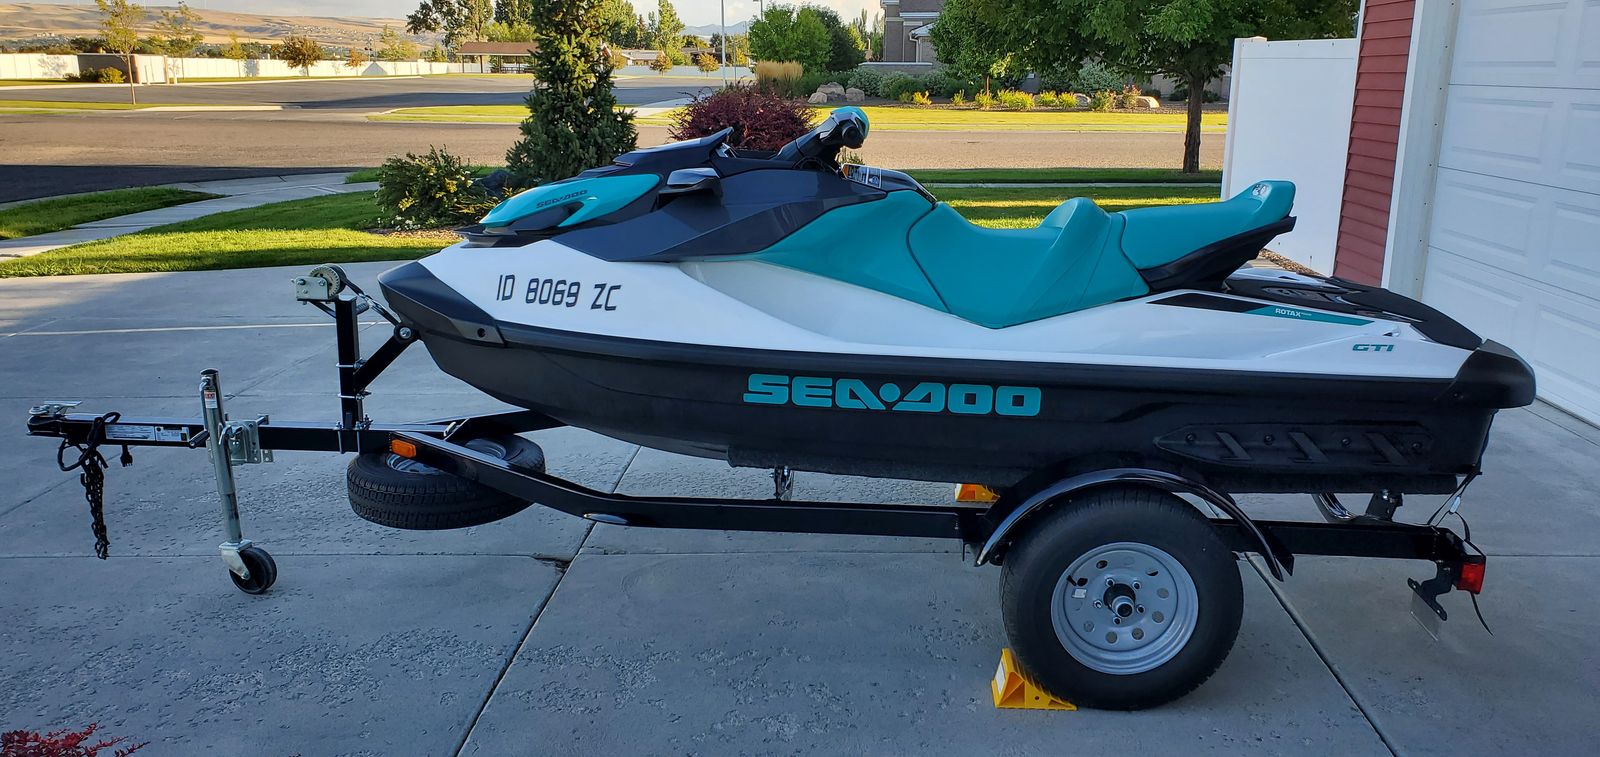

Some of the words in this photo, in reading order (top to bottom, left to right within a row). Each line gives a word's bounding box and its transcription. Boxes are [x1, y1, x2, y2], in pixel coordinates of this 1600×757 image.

[496, 274, 515, 301] ID
[525, 277, 581, 308] 8069
[590, 283, 622, 311] ZC
[1275, 308, 1301, 317] ROTAX
[1352, 343, 1395, 352] GTI
